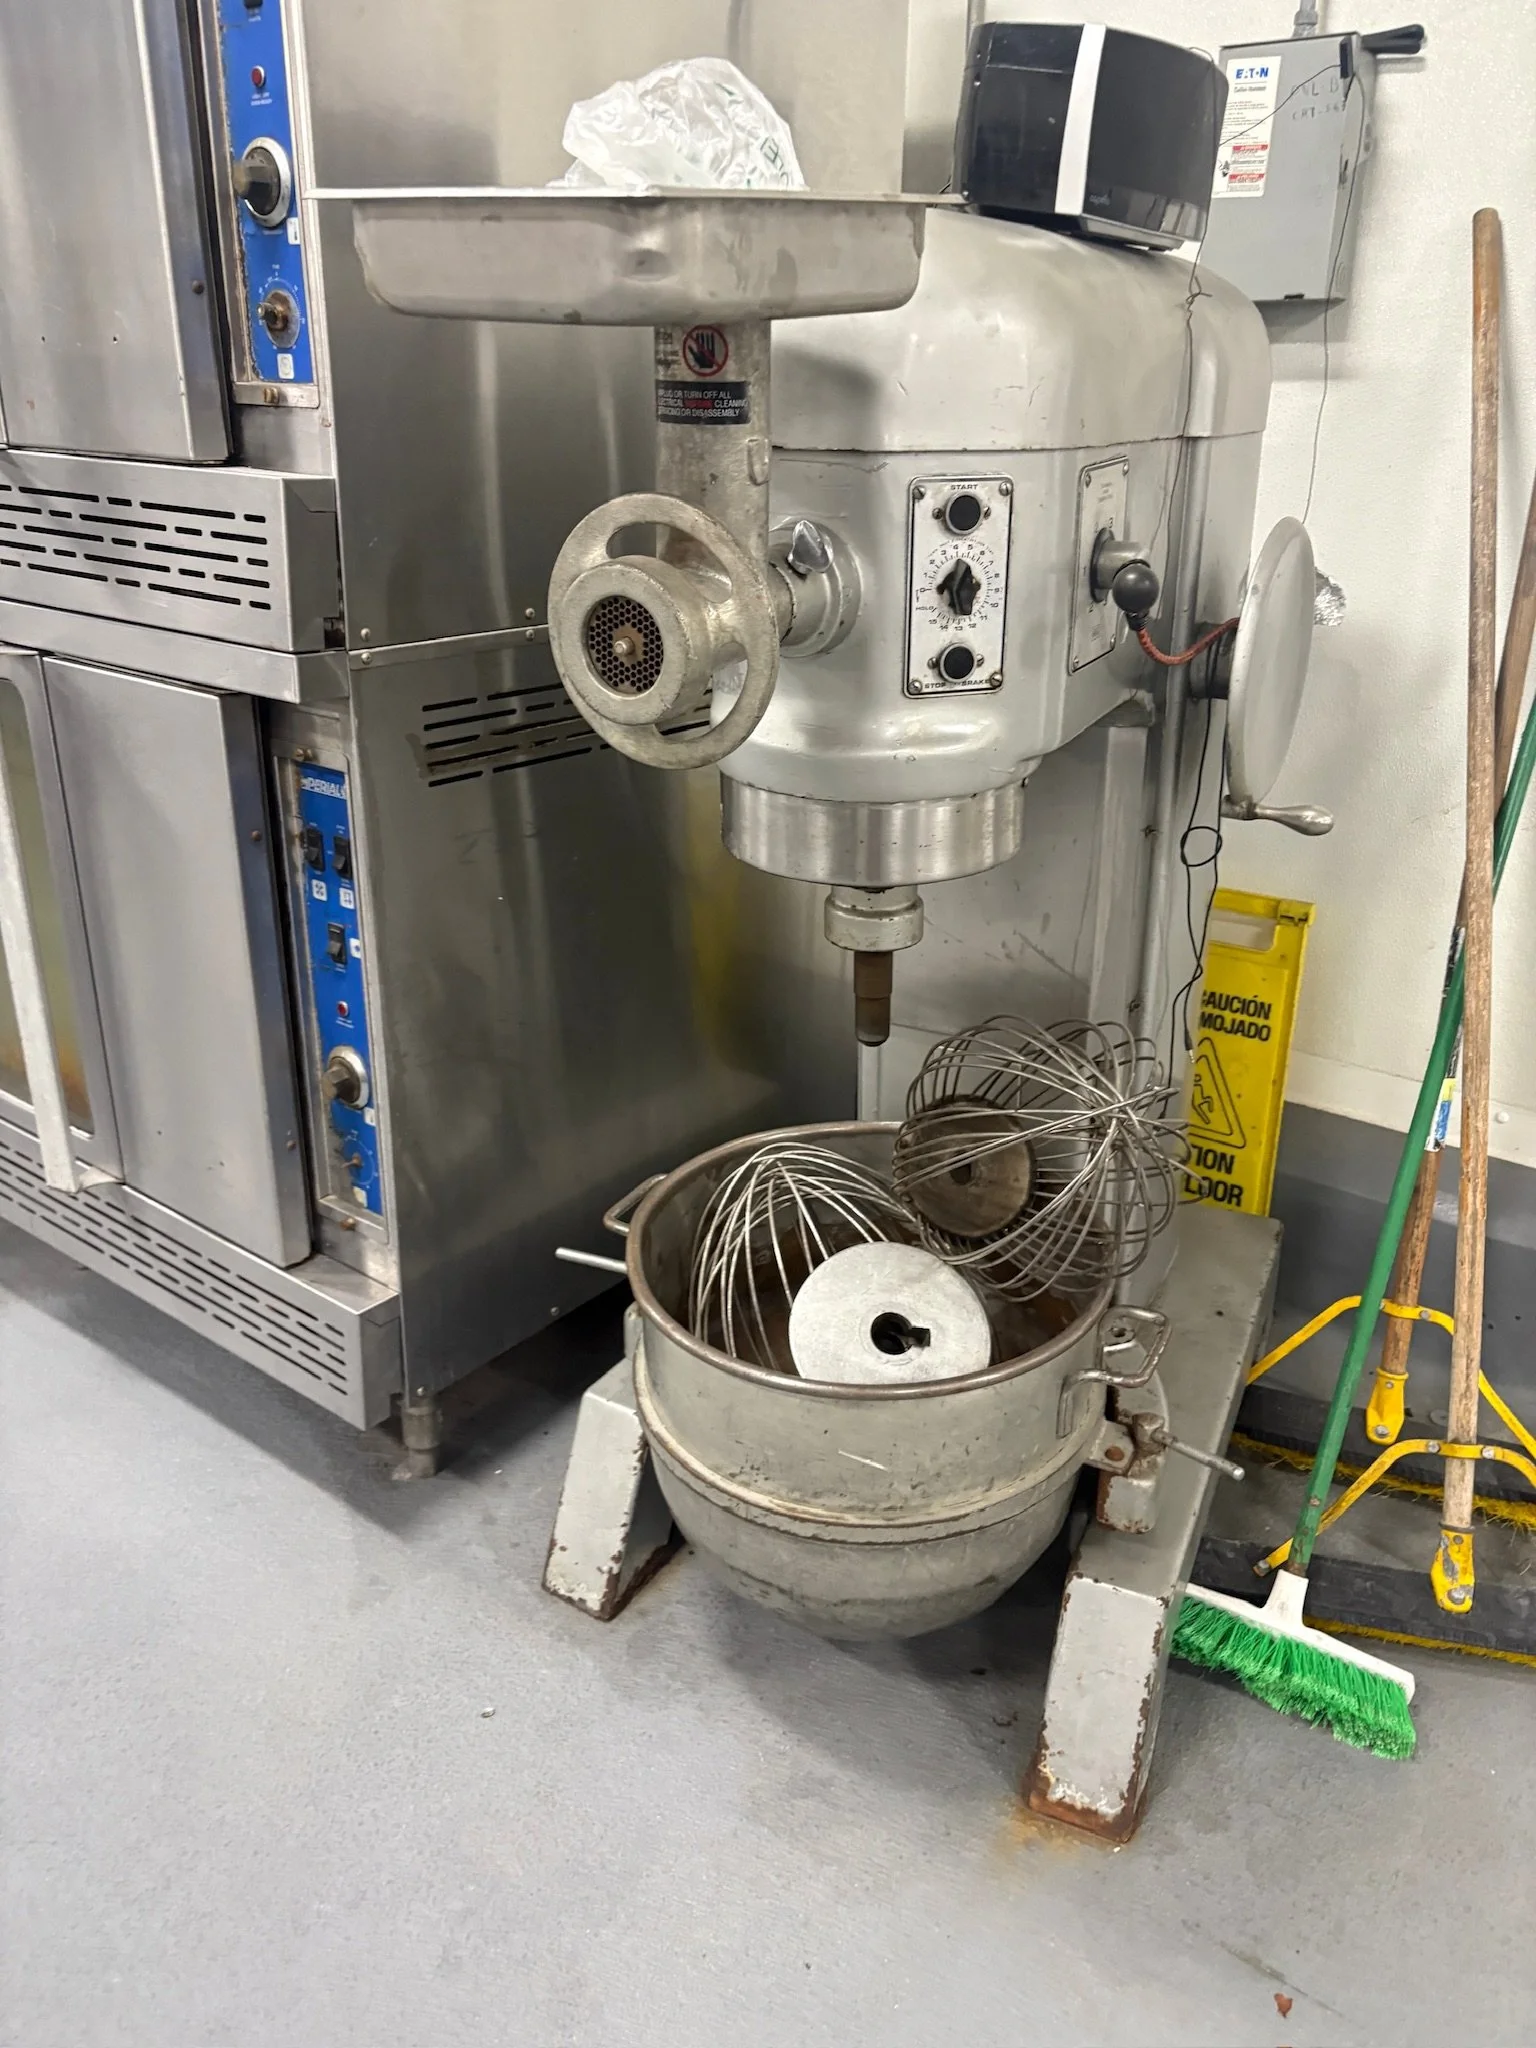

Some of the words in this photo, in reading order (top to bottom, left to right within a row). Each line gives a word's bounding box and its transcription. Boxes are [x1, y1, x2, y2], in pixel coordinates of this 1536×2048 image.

[674, 390, 683, 398] OR
[684, 390, 702, 398] TURN
[703, 391, 718, 399] OFF
[719, 391, 731, 399] ALL
[714, 400, 748, 408] CLEANING
[681, 408, 691, 416] OR
[692, 408, 740, 417] DISASSEMBLY
